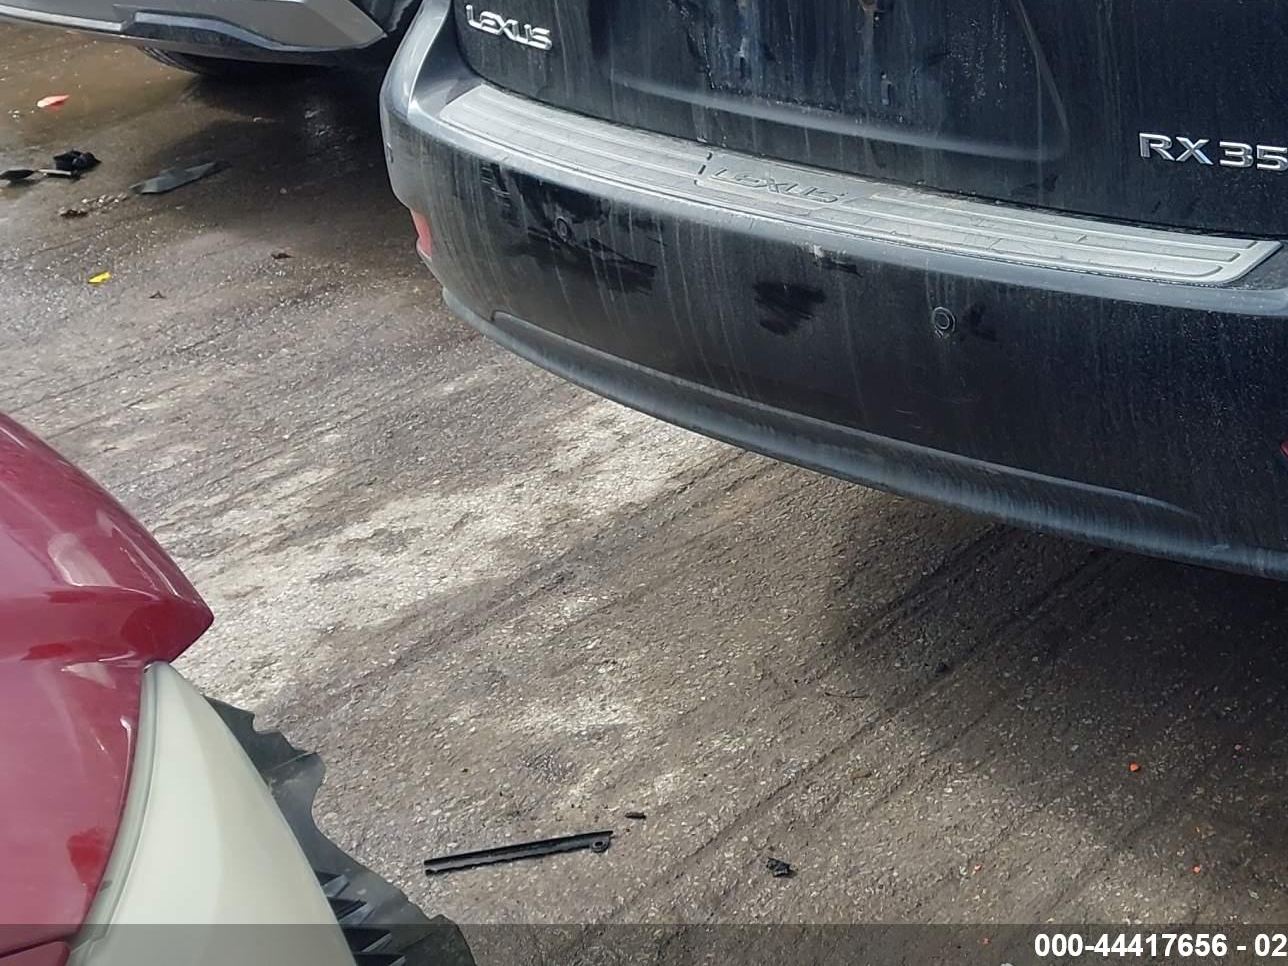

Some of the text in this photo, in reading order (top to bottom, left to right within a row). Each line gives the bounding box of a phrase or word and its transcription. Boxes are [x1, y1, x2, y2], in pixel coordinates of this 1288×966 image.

[465, 4, 553, 51] LEXUS
[1138, 132, 1214, 166] RX
[709, 167, 848, 204] LEXUS
